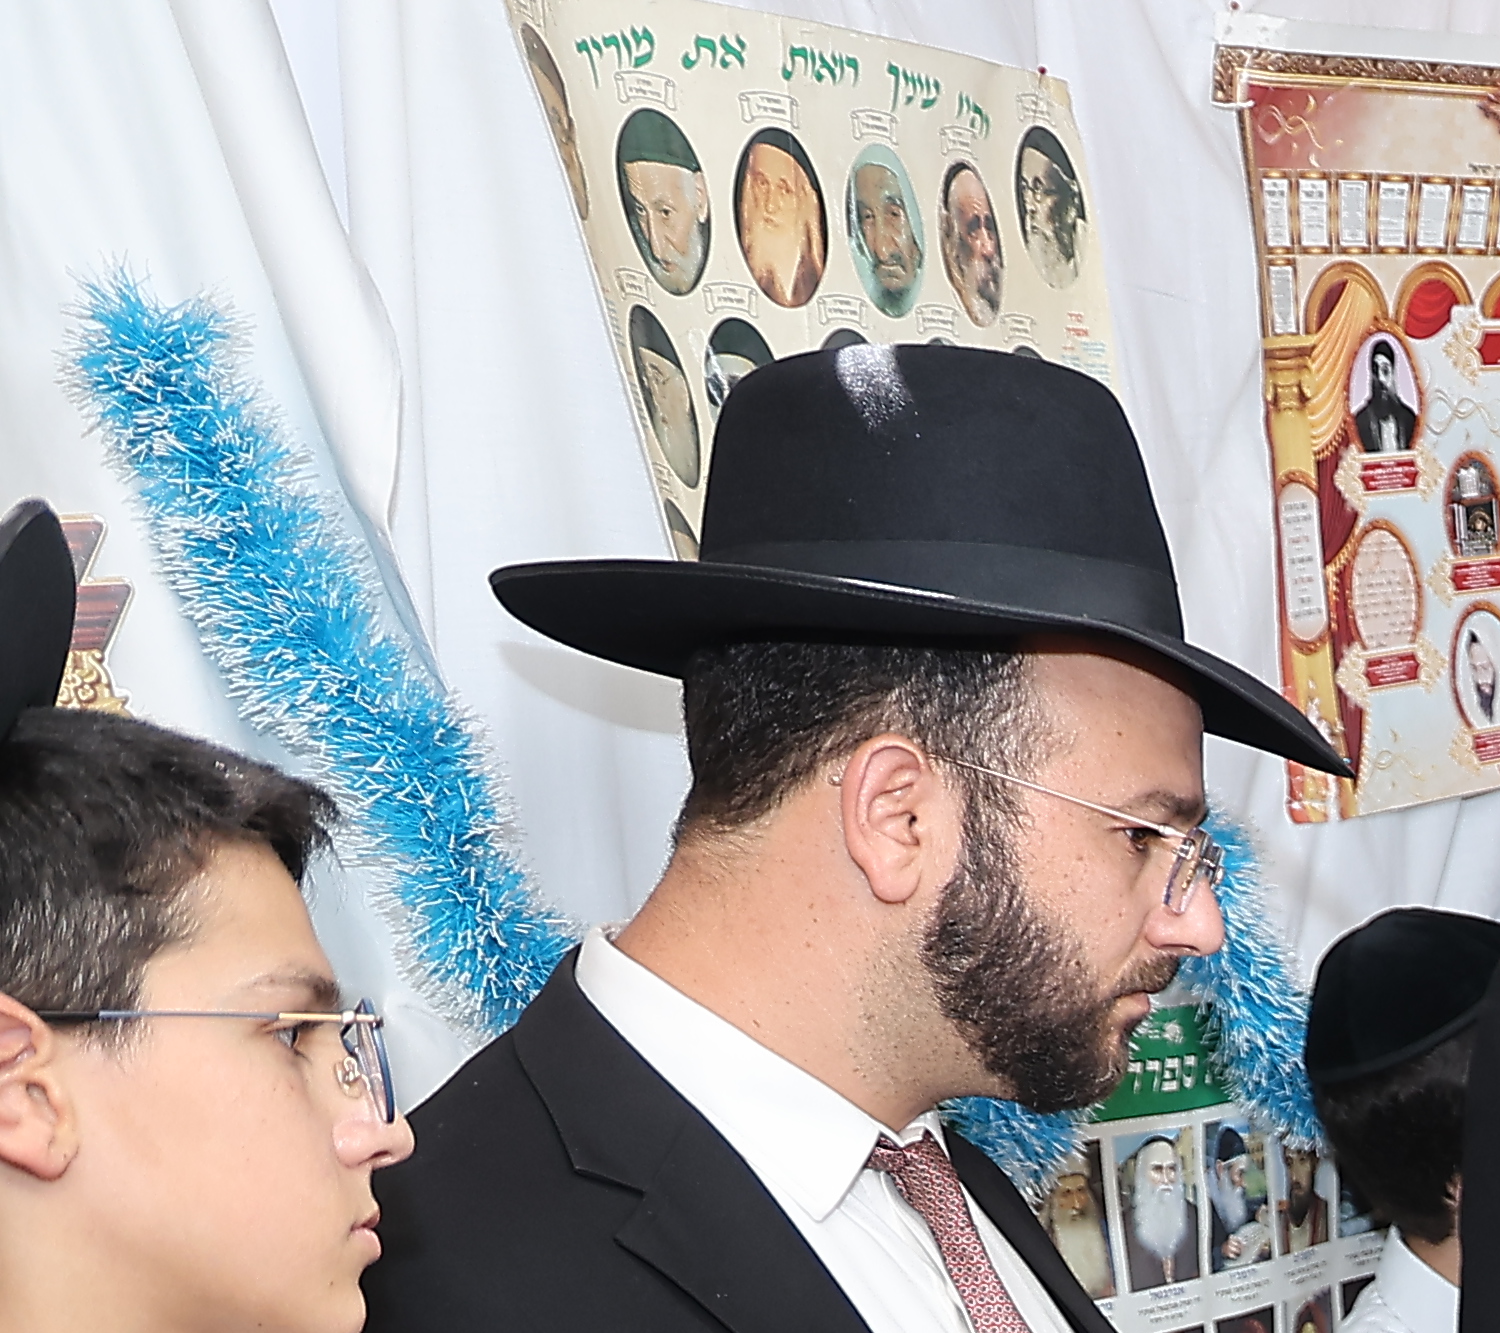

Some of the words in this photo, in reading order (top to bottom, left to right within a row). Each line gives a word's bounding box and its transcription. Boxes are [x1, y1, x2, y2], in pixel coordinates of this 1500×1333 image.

[575, 25, 655, 89] מוריך
[681, 34, 746, 69] את
[782, 45, 859, 87] רואות
[886, 61, 940, 112] עיניך
